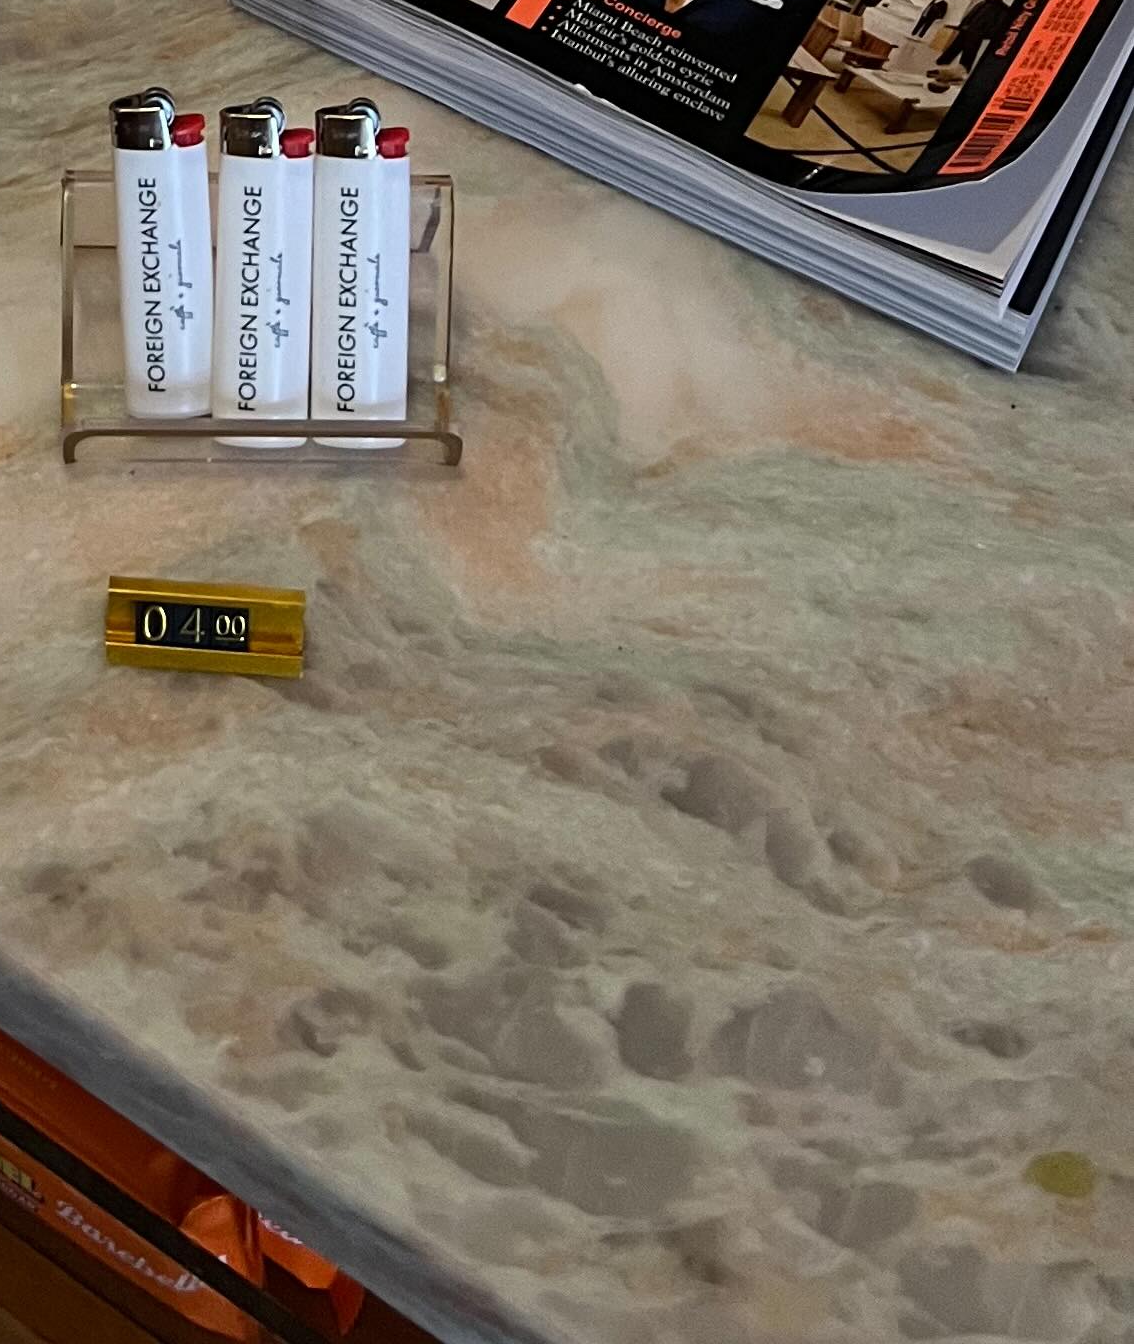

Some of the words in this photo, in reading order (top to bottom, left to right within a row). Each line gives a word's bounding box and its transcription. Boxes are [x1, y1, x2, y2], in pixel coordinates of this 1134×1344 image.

[550, 29, 616, 68] Istanbul's
[616, 62, 672, 98] alluring
[672, 91, 726, 123] enclave
[556, 19, 632, 61] Allotments
[633, 56, 649, 71] in
[649, 64, 732, 111] Amsterdam
[565, 8, 628, 47] Mayfair's
[629, 42, 678, 69] golden
[678, 64, 715, 88] eyrie
[620, 21, 663, 49] Beach
[664, 43, 739, 85] reinvented
[137, 175, 162, 295] EXCHANGE
[240, 184, 264, 309] EXCHANGE
[338, 186, 361, 309] EXCHANGE
[144, 299, 168, 395] FOREIGN
[237, 313, 259, 414] FOREIGN
[336, 313, 357, 414] FOREIGN
